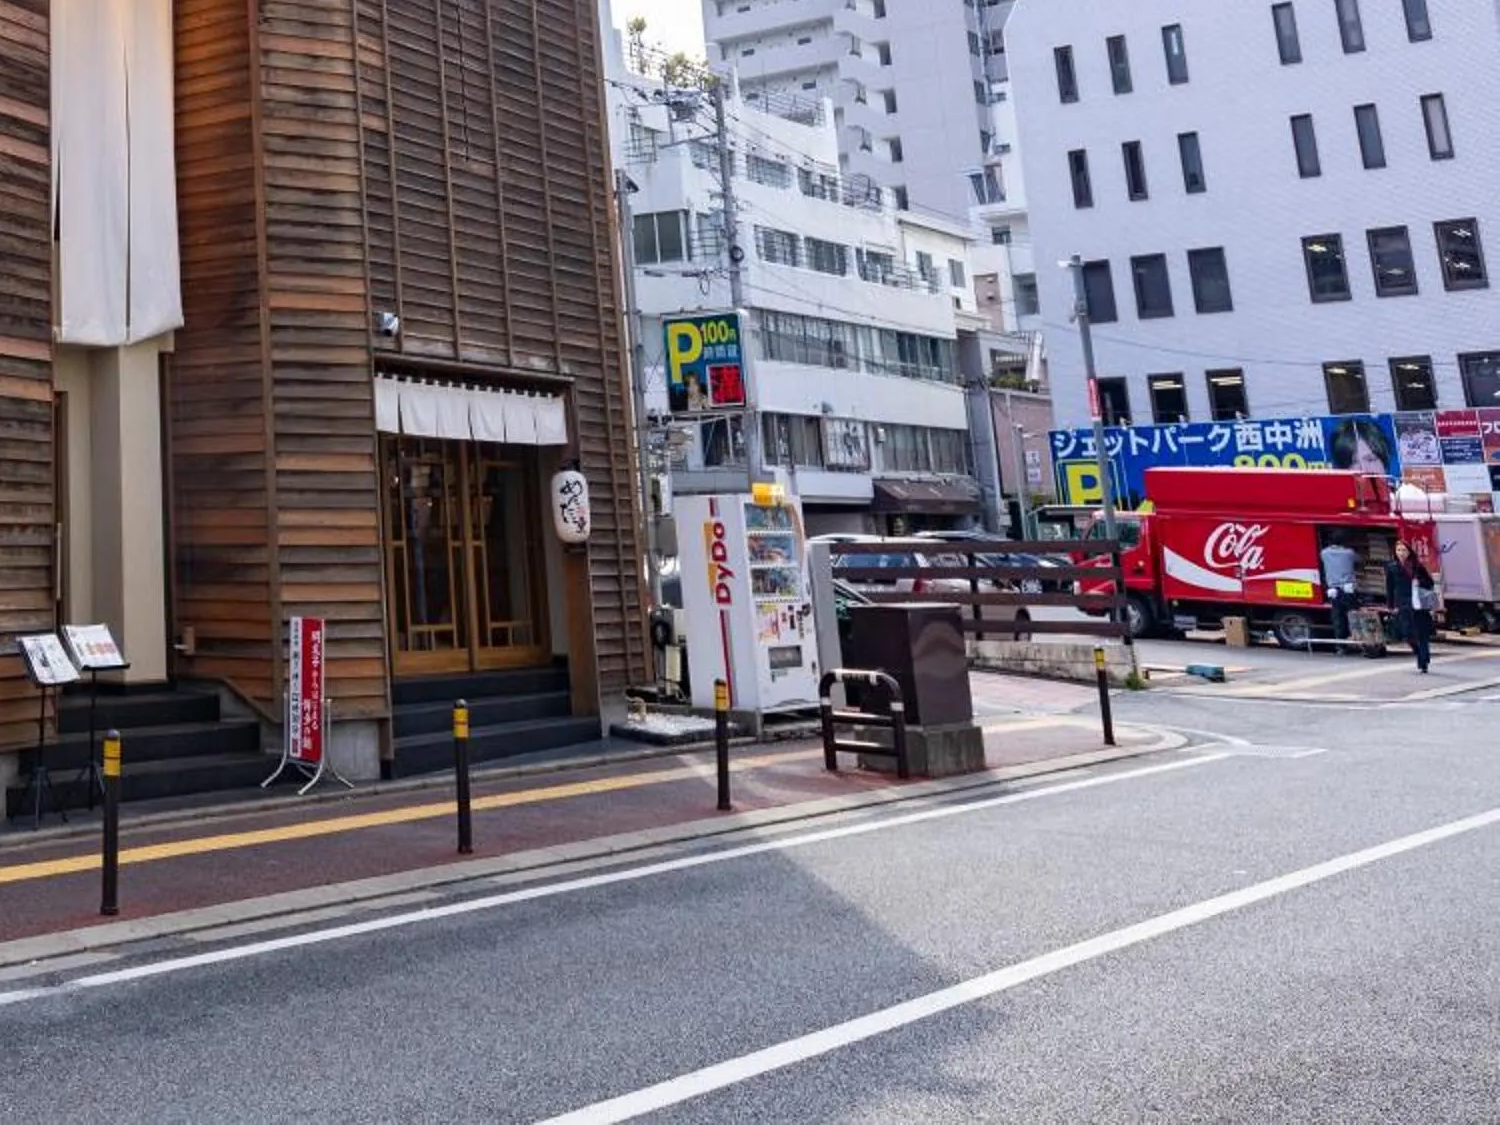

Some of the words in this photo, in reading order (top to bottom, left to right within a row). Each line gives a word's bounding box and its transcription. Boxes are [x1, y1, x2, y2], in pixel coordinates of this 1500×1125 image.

[668, 322, 703, 384] P
[1053, 418, 1324, 457] ジェットパーク西中洲
[711, 522, 735, 605] DyDo
